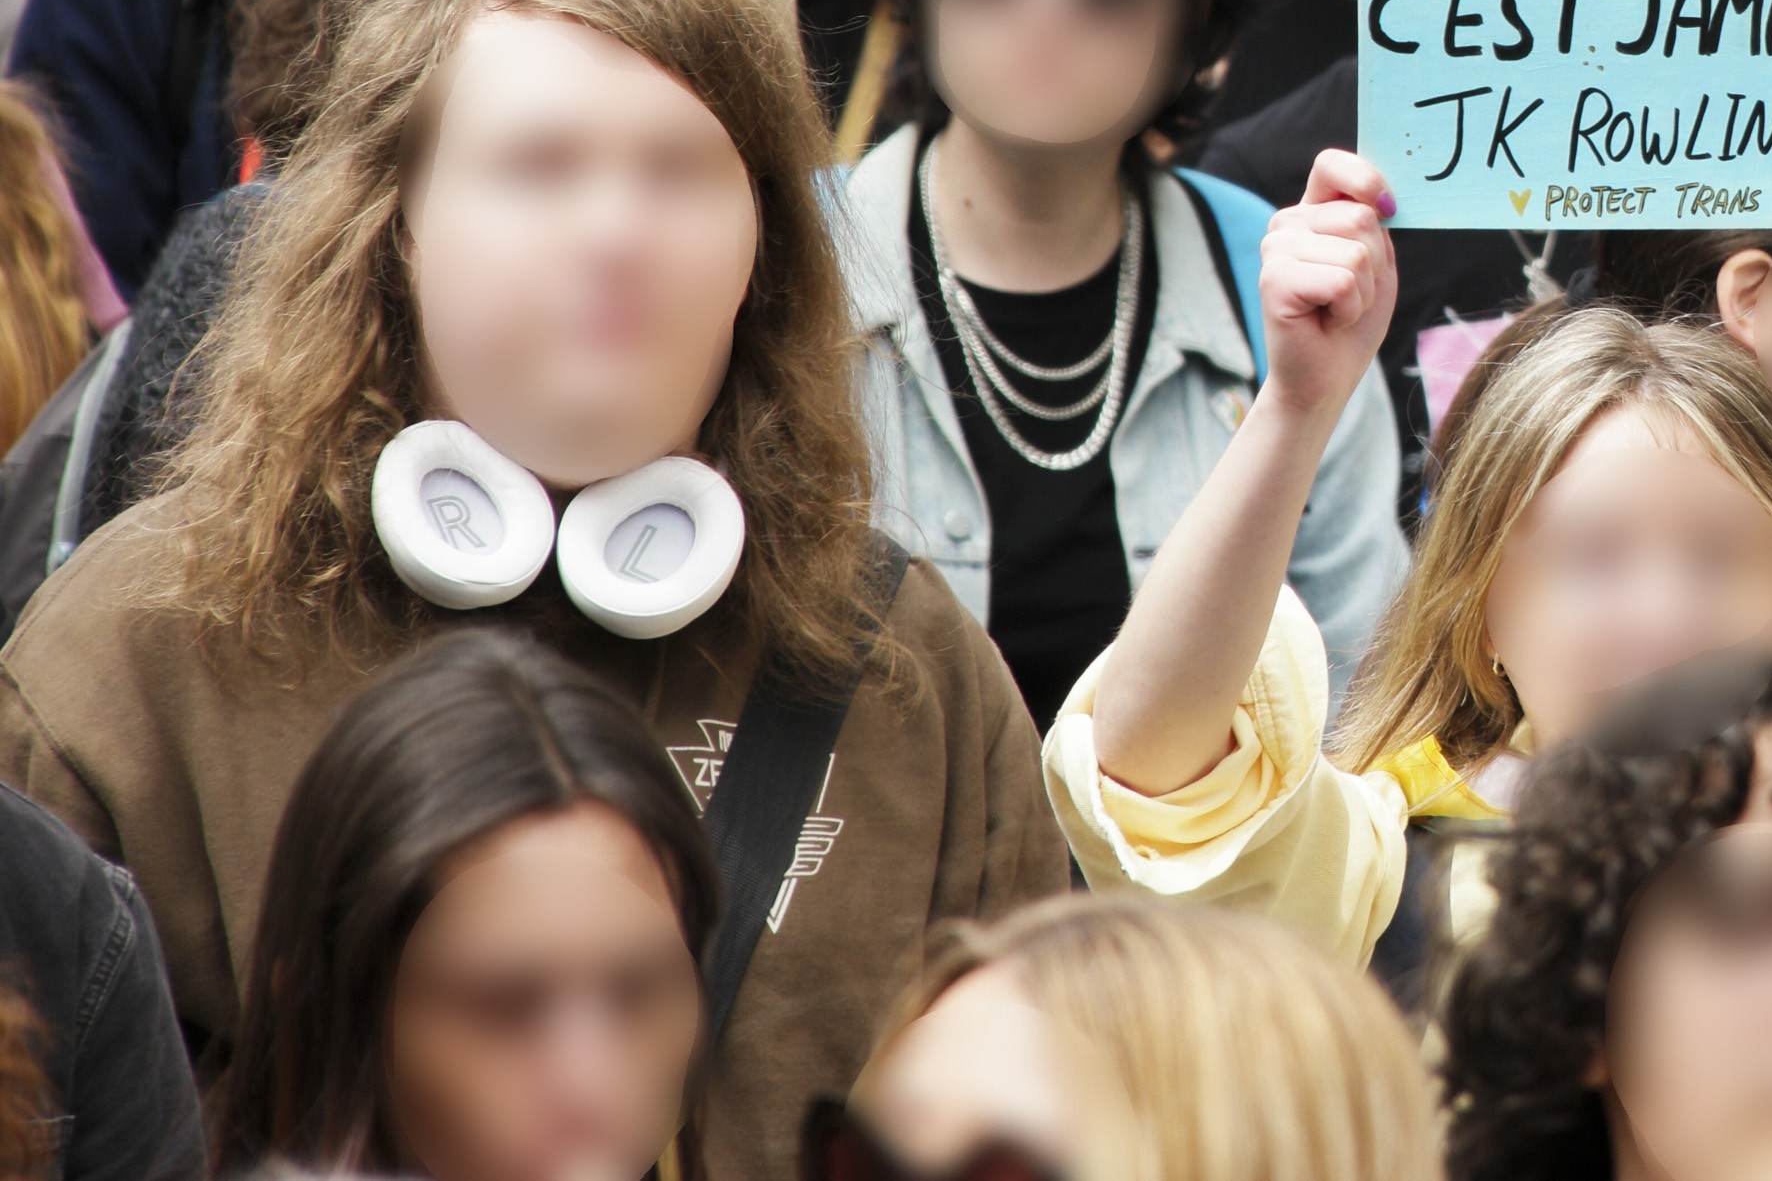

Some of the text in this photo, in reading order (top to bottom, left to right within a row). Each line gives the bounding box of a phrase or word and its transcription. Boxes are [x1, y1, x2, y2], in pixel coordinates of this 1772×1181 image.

[1413, 85, 1545, 182] JK
[1674, 182, 1763, 219] TRANS
[425, 494, 487, 551] R
[618, 523, 660, 584] L
